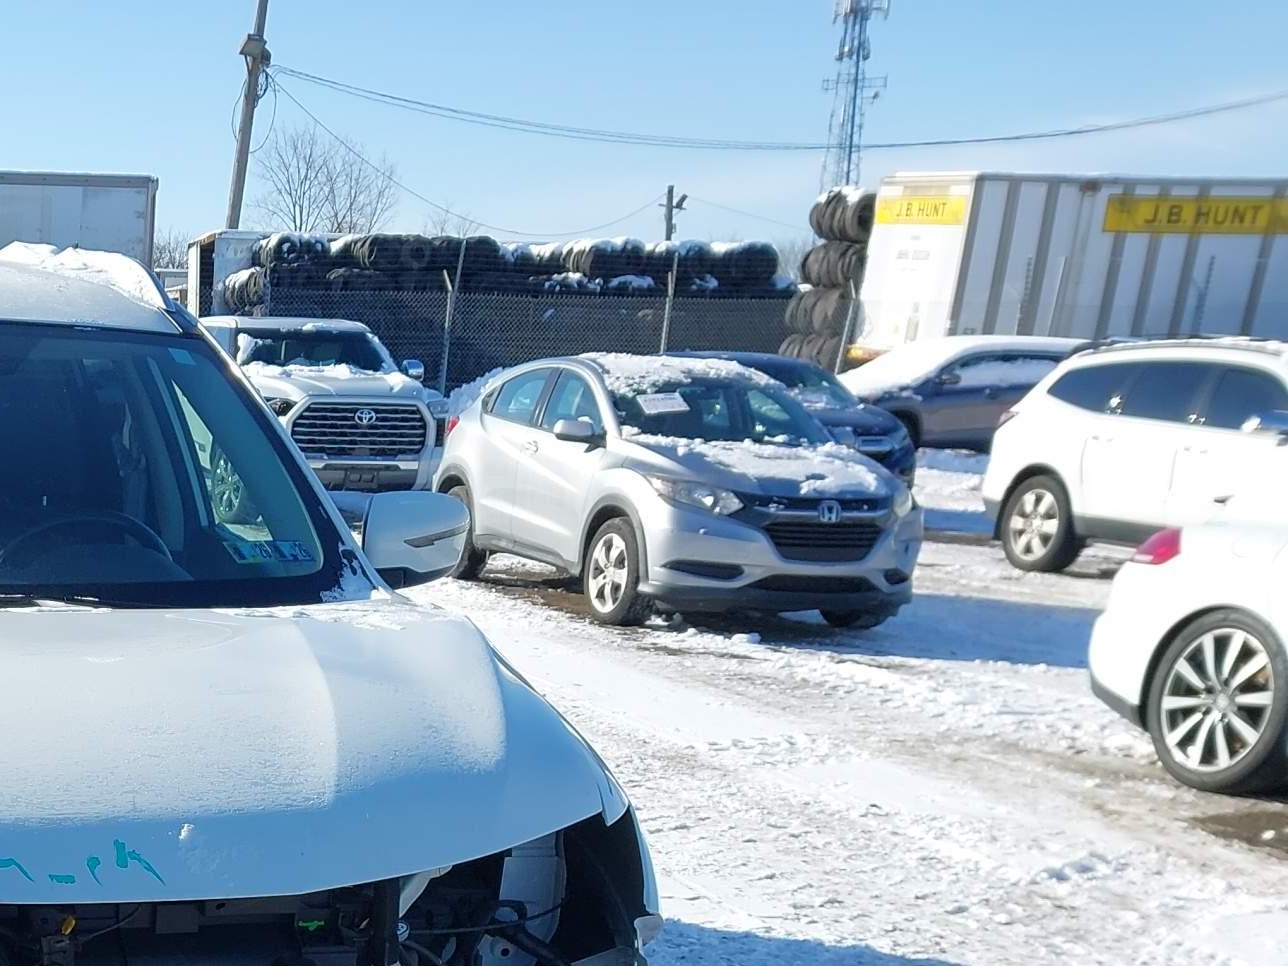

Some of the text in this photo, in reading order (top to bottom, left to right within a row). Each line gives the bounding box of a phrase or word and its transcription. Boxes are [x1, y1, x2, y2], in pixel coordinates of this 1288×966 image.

[917, 202, 947, 217] HUNT
[1143, 204, 1264, 225] J.B. HUNT
